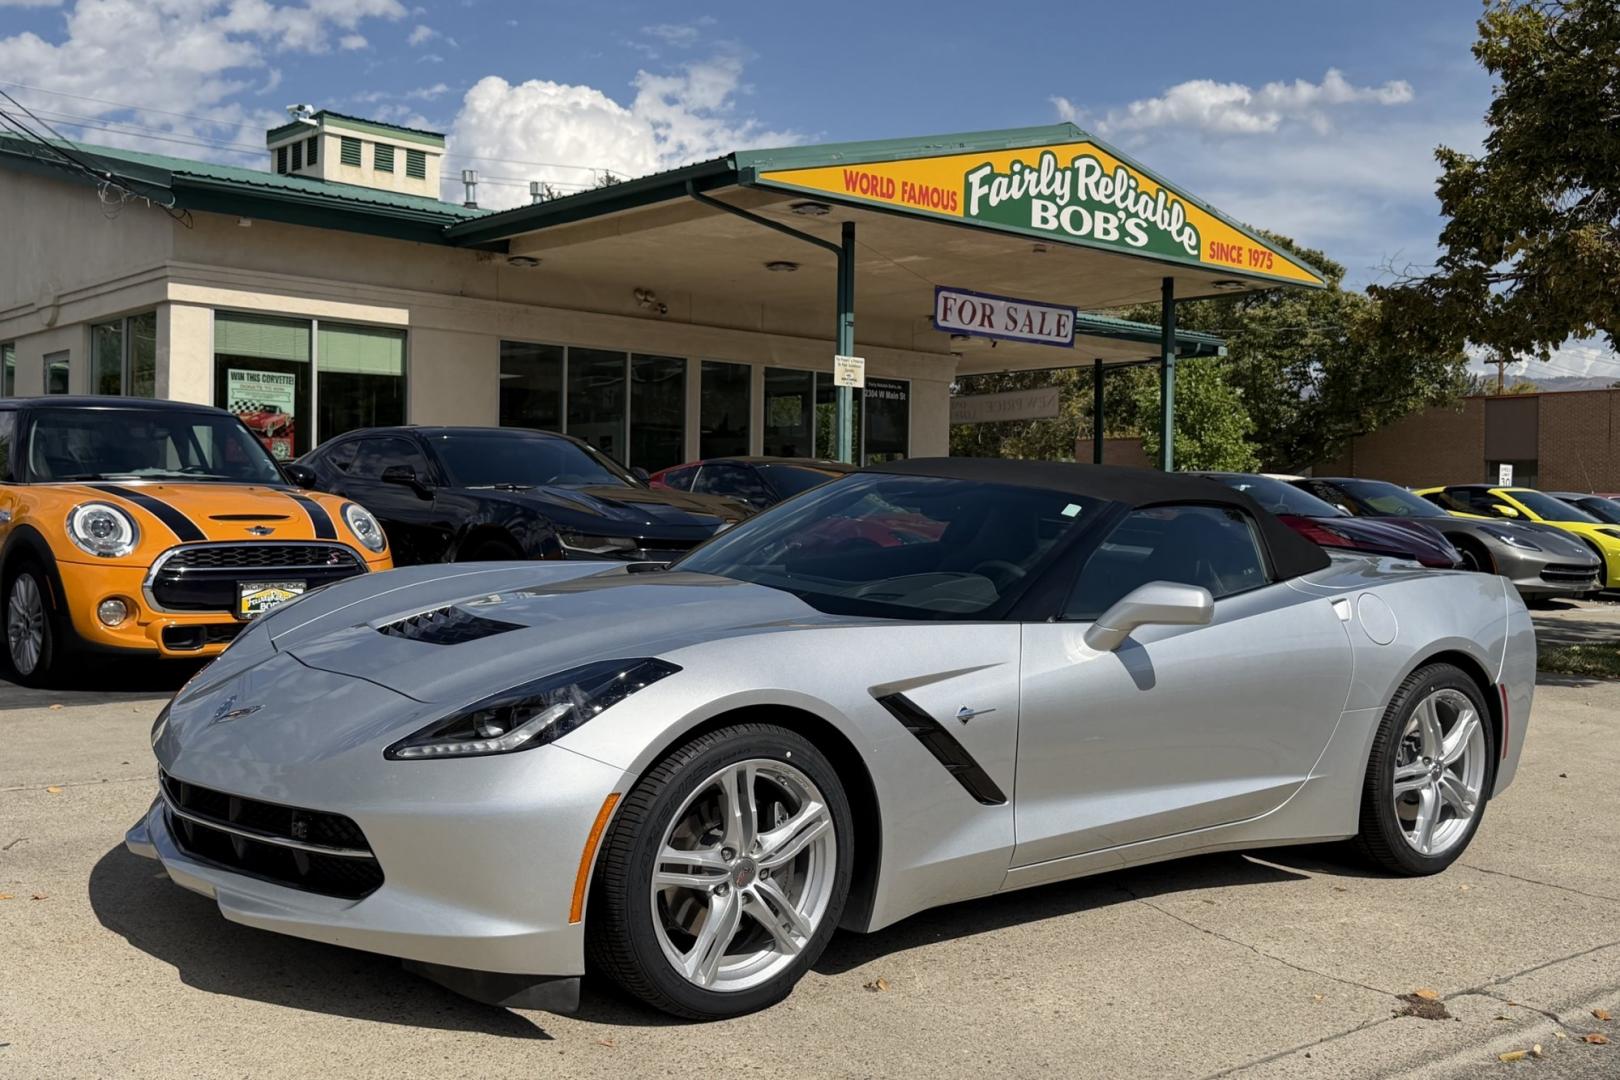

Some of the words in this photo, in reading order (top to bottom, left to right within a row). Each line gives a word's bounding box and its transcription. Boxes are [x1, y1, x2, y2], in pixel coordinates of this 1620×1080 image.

[843, 169, 895, 199] WORLD
[901, 181, 957, 212] FAMOUS
[968, 153, 1072, 216] Fairly
[1074, 157, 1198, 255] Reliable
[1031, 198, 1149, 247] BOB'S
[1209, 241, 1243, 264] SINCE
[1248, 248, 1273, 270] 1975
[941, 296, 995, 329] FOR
[1005, 306, 1070, 338] SALE
[231, 372, 245, 381] WIN
[246, 373, 260, 382] THIS
[879, 390, 885, 399] W
[885, 391, 899, 400] Main
[899, 392, 906, 400] St
